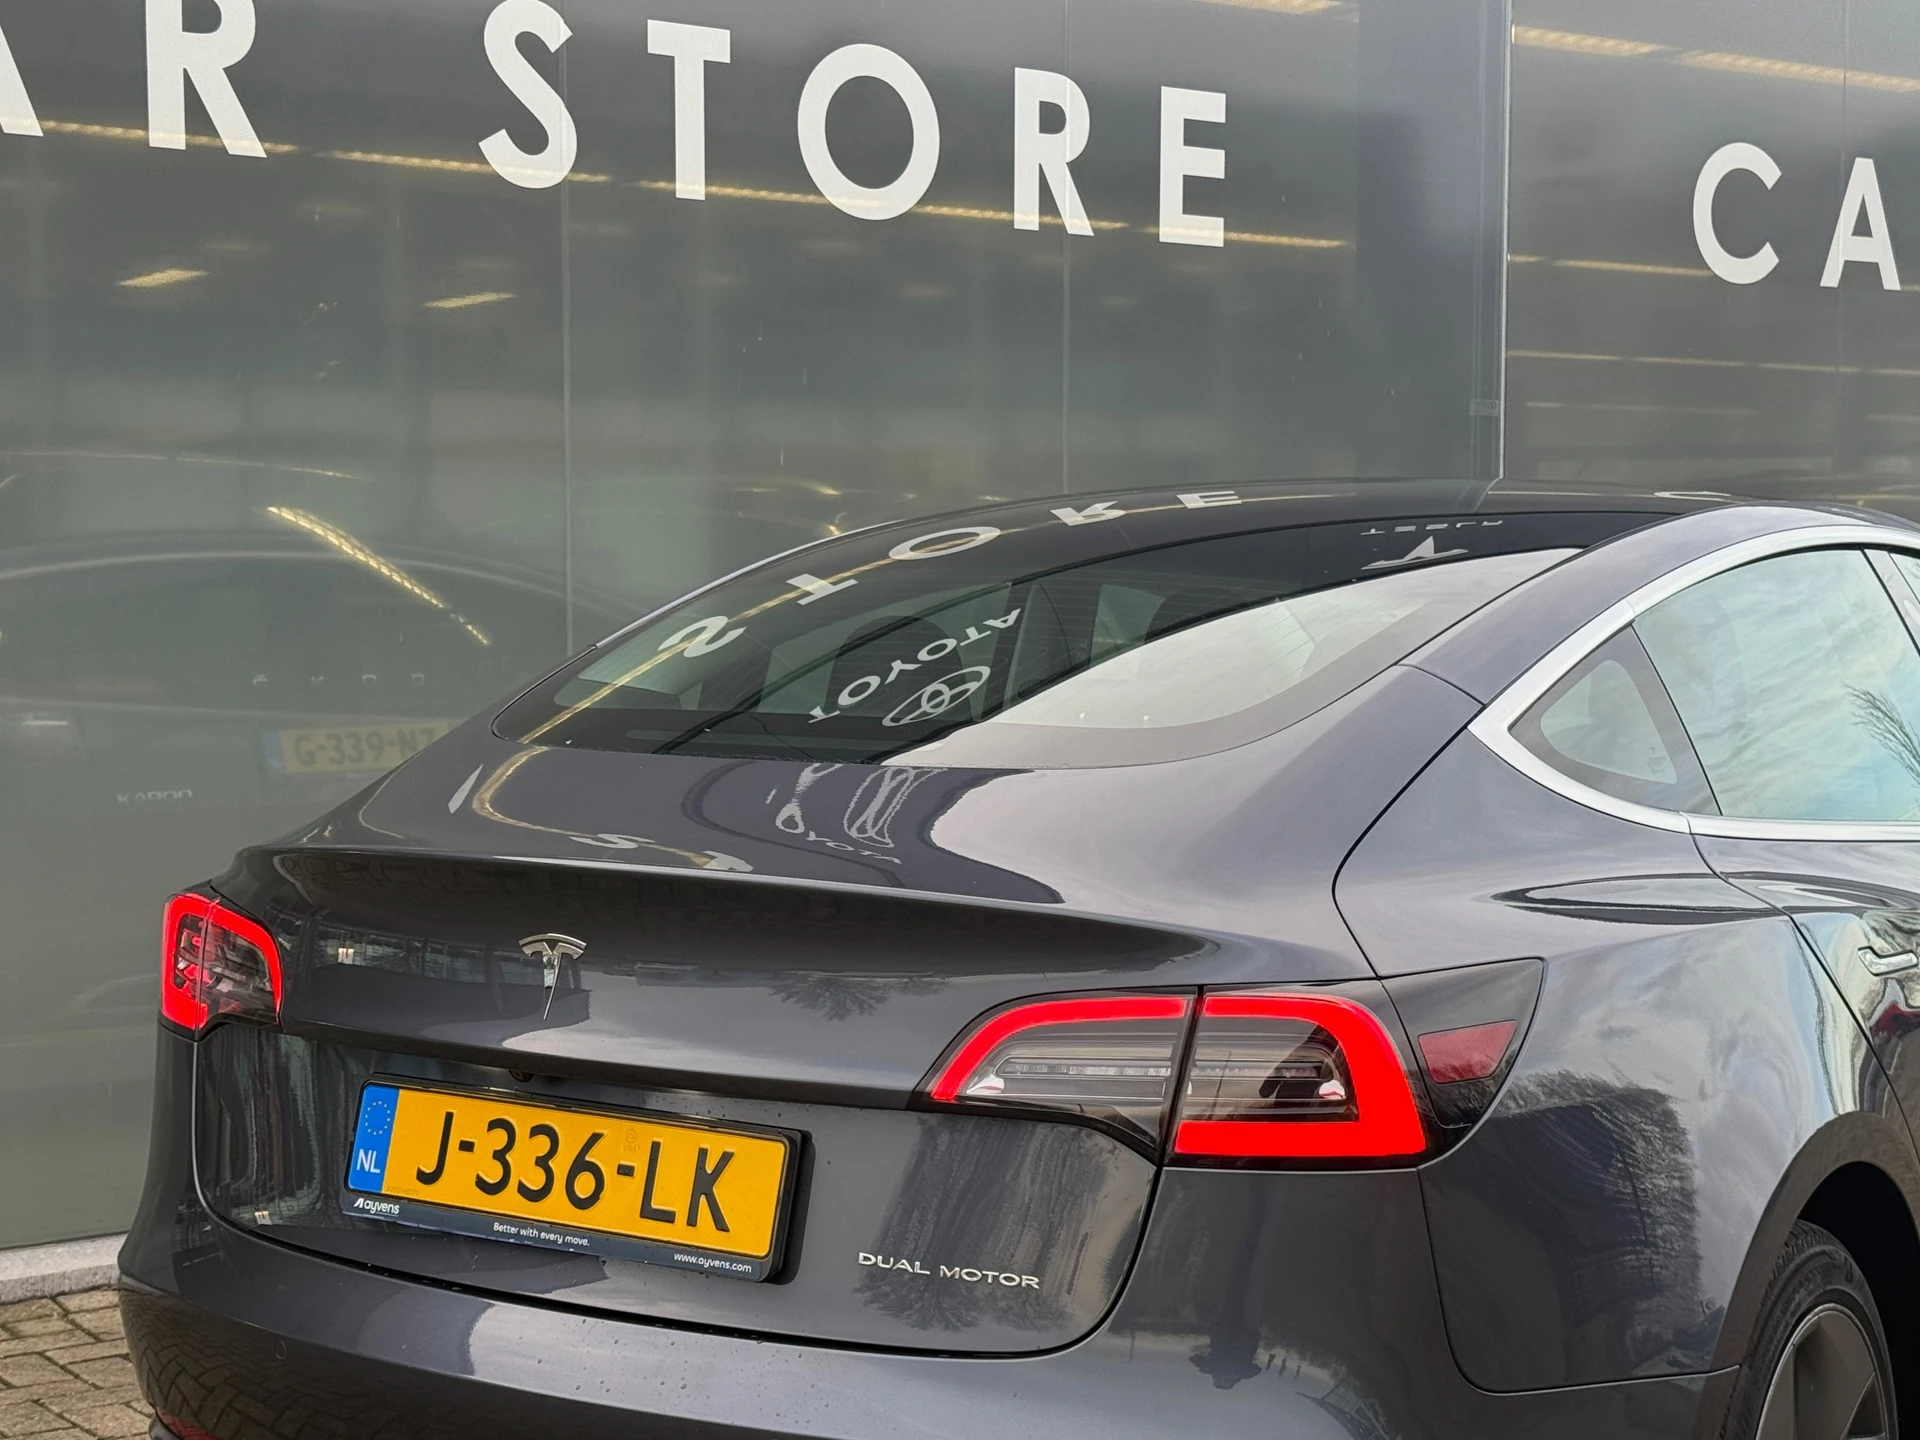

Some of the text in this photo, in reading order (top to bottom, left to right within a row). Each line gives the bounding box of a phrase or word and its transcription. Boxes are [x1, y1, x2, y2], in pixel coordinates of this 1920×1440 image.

[479, 0, 1226, 248] STORE
[1693, 142, 1901, 291] CA
[356, 1148, 381, 1174] NL
[415, 1111, 735, 1233] J-336-LK
[364, 1200, 400, 1214] ayvens
[493, 1222, 590, 1246] Better with every move.
[674, 1253, 752, 1273] www.ayvens.com
[858, 1252, 1040, 1289] DUAL MOTOR
